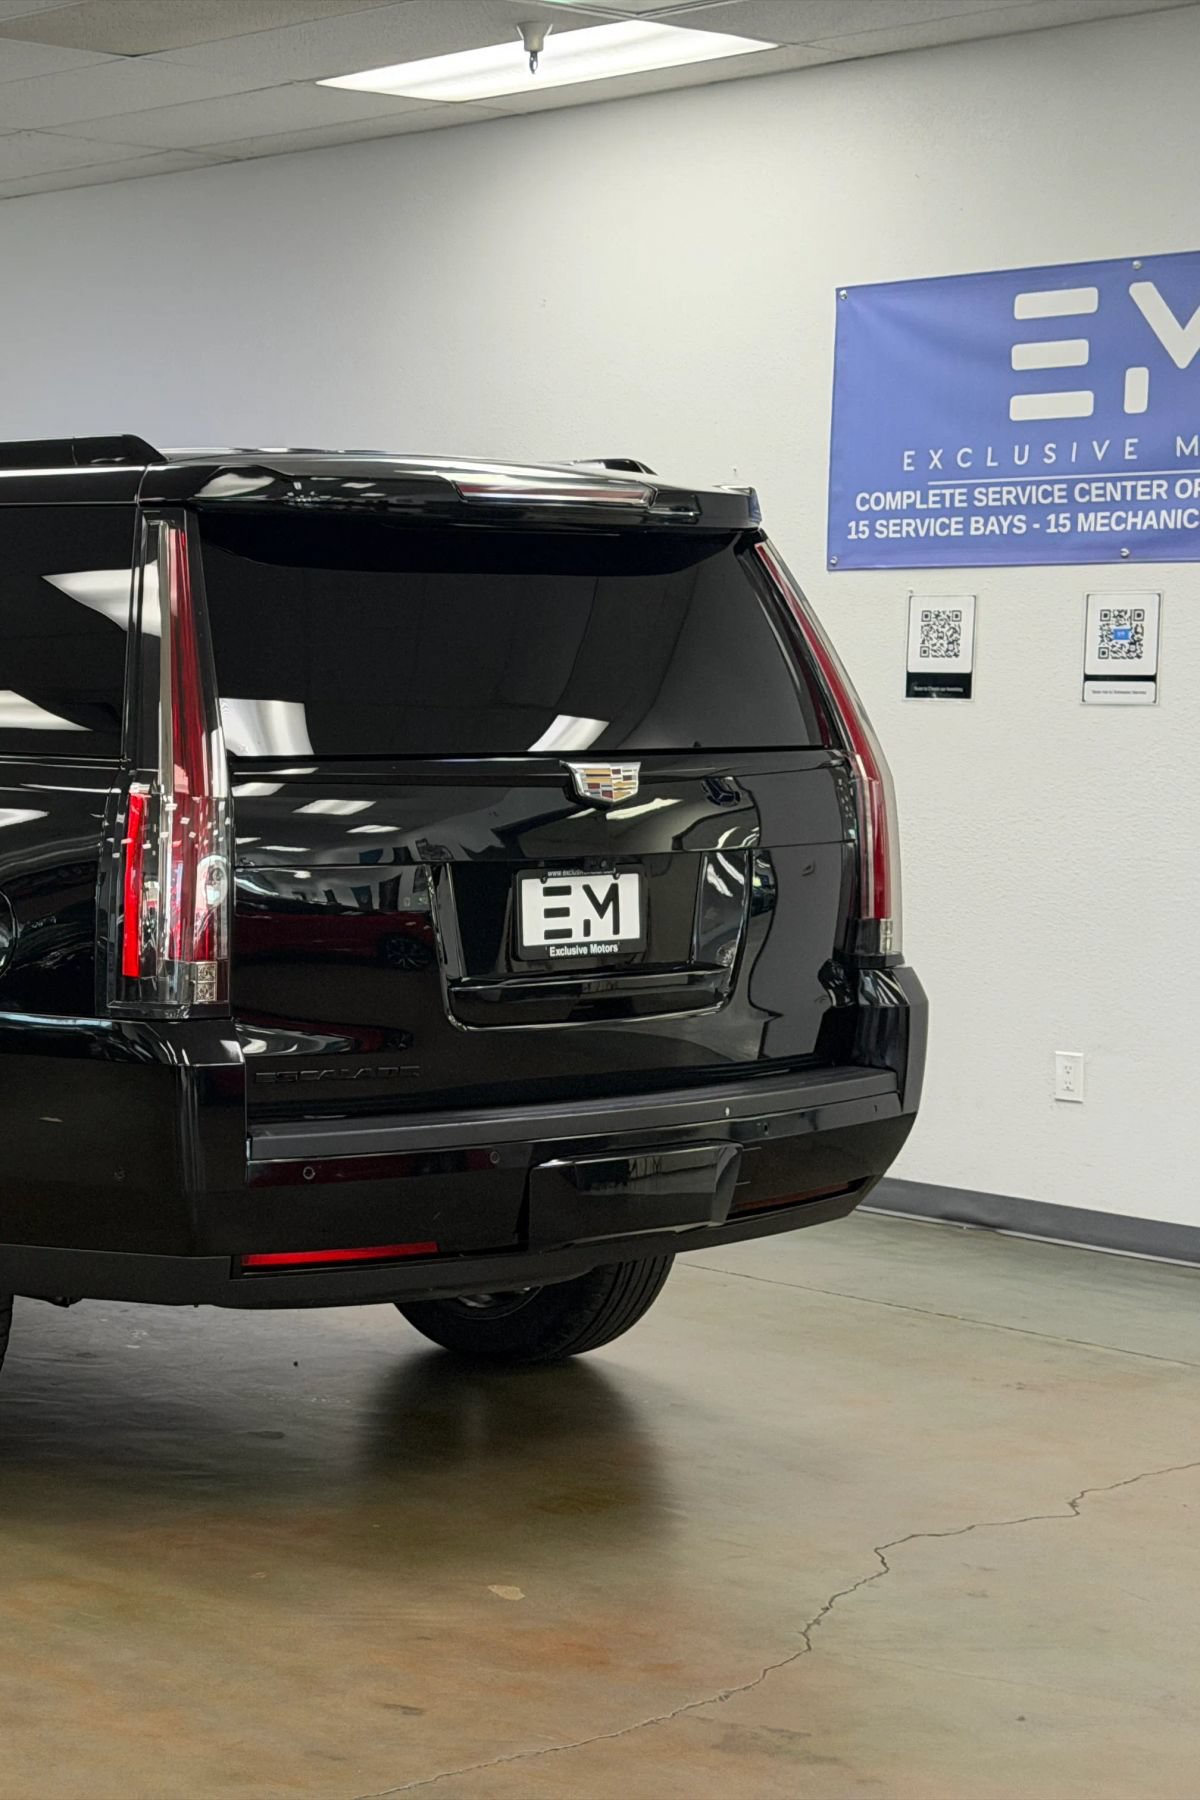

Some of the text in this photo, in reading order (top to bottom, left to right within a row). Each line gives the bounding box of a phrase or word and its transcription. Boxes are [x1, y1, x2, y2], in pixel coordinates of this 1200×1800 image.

[902, 437, 1140, 472] EXCLUSIVE
[855, 487, 968, 512] COMPLETE
[973, 484, 1068, 508] SERVICE
[1074, 479, 1168, 503] CENTER
[847, 520, 870, 540] 15
[874, 516, 964, 539] SERVICE
[969, 514, 1027, 537] BAYS
[1046, 512, 1071, 534] 15
[543, 882, 620, 940] EM
[549, 942, 619, 957] Exclusive Motors
